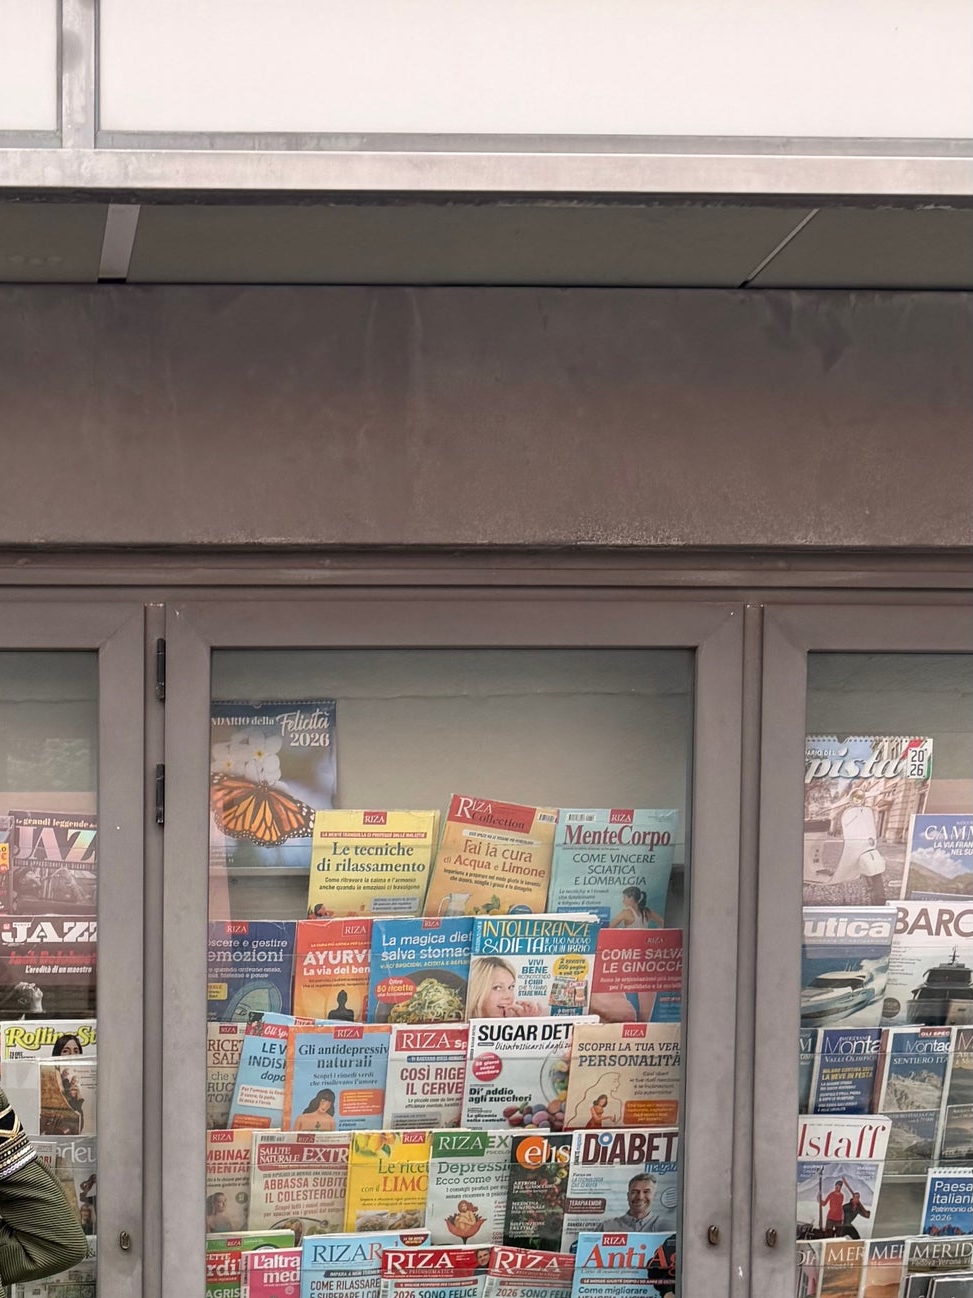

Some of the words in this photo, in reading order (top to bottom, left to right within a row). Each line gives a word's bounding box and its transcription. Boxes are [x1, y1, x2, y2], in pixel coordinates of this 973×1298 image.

[251, 715, 275, 726] della
[290, 732, 330, 747] 2026
[910, 750, 925, 763] 20
[910, 764, 925, 777] 26
[23, 818, 50, 827] grandi
[53, 819, 88, 828] leggende
[364, 814, 386, 824] RIZA
[563, 823, 672, 851] MenteCorpo
[332, 842, 350, 857] Le
[354, 840, 414, 857] tecniche
[572, 853, 605, 864] COME
[609, 853, 656, 864] VINCERE
[316, 860, 332, 877] di
[335, 859, 426, 878] rilassamento
[454, 855, 491, 873] Acqua
[501, 862, 546, 879] Limone
[587, 865, 637, 875] SCIATICA
[583, 876, 646, 887] LOMBALGIA
[345, 926, 368, 935] RIZA
[482, 921, 589, 938] INTOLLERANZE
[252, 939, 288, 951] gestire
[401, 933, 443, 950] magica
[381, 949, 416, 961] salva
[601, 949, 640, 962] COME
[67, 965, 92, 973] maestro
[522, 966, 548, 975] BENE
[337, 1030, 360, 1038] RIZA
[478, 1023, 539, 1042] SUGAR
[402, 1033, 451, 1049] RIZA
[298, 1042, 315, 1056] Gli
[577, 1042, 617, 1052] SCOPRI
[317, 1055, 372, 1069] naturali
[893, 1056, 931, 1065] SENTIERO
[487, 1086, 514, 1095] addio
[489, 1093, 533, 1103] zuccheri
[439, 1137, 484, 1151] RIZA
[260, 1147, 291, 1157] SALUTE
[260, 1154, 301, 1165] NATURALE
[263, 1179, 311, 1192] ABBASSA
[436, 1177, 457, 1186] Ecco
[931, 1205, 965, 1213] Patrimonio
[603, 1236, 626, 1246] RIZA
[494, 1250, 562, 1277] RIZA
[311, 1283, 333, 1293] COME
[418, 1287, 446, 1298] SONO
[449, 1286, 478, 1298] FELICE
[495, 1287, 518, 1298] 2026
[578, 1285, 601, 1295] Come
[603, 1285, 648, 1298] migliorare
